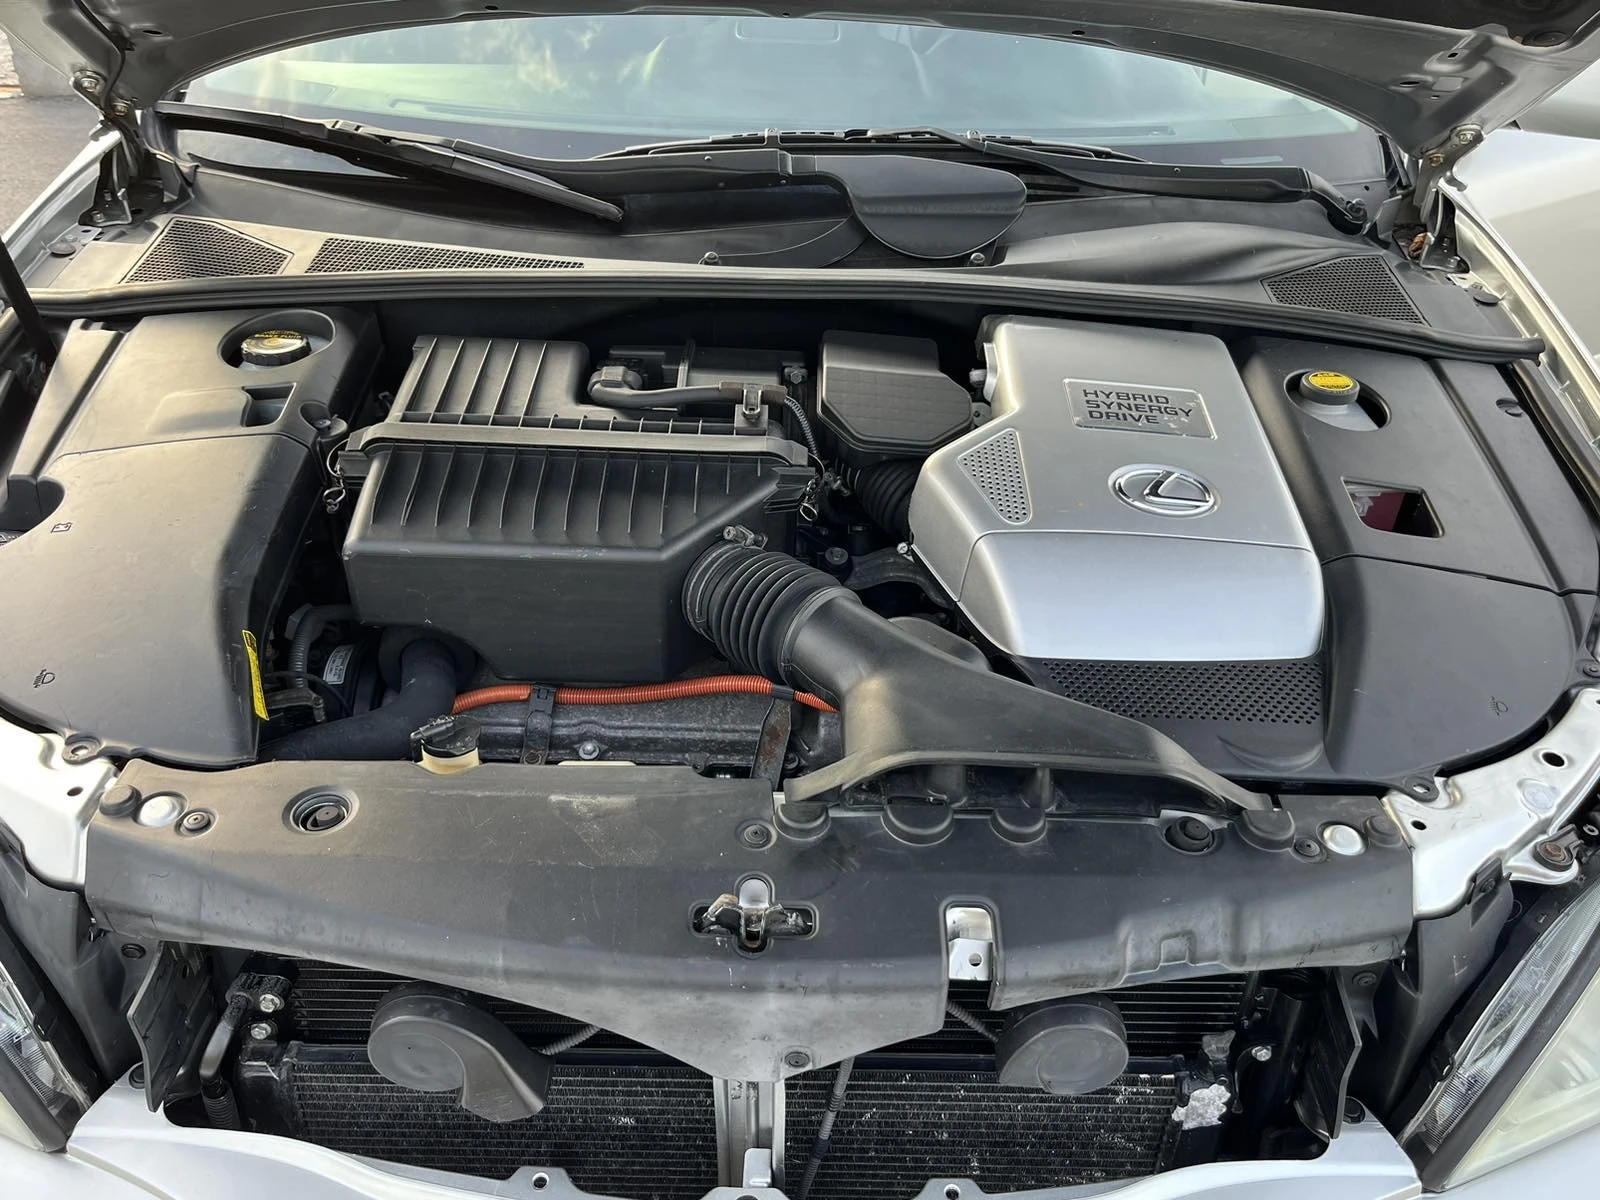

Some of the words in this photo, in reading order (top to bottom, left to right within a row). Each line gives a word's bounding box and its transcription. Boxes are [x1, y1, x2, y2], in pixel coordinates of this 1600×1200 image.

[1082, 389, 1169, 405] HYBRID
[1085, 400, 1193, 417] SYNERGY
[1088, 410, 1160, 424] DRIVE
